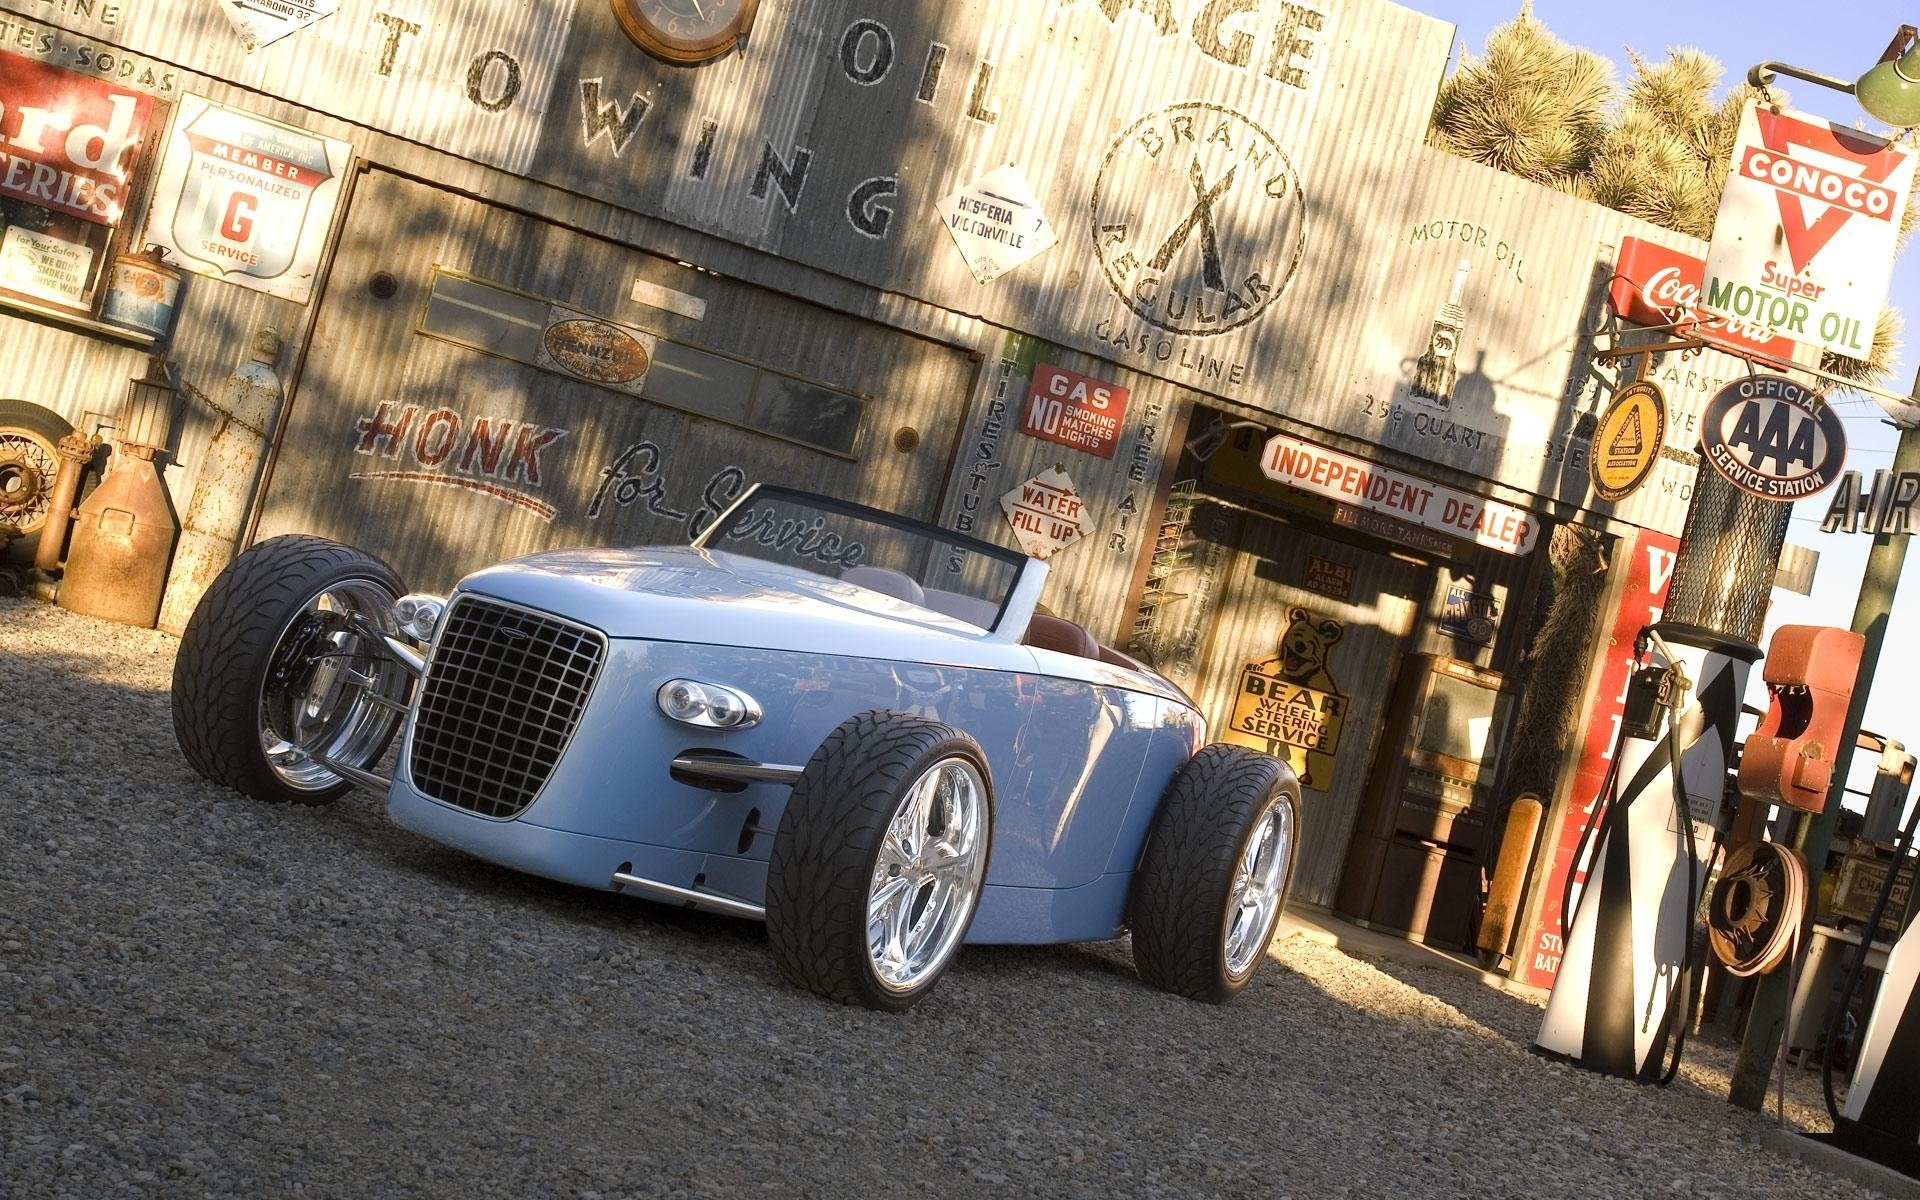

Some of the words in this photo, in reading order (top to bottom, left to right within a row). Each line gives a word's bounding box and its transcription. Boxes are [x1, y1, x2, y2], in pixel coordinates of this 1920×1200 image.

[50, 0, 120, 26] INE
[296, 10, 311, 21] 32
[668, 17, 678, 33] 6
[687, 18, 699, 34] 5
[706, 10, 716, 26] 4
[75, 46, 175, 92] SODAS
[837, 18, 998, 127] OIL
[0, 94, 137, 178] rd
[373, 11, 899, 240] TOWING
[213, 143, 299, 180] MEMBER
[258, 140, 294, 160] AMERICA
[1138, 115, 1288, 200] BRAND
[200, 162, 301, 200] PERSONALIZED
[1748, 154, 1889, 215] CONOCO
[220, 191, 258, 243] G
[951, 214, 1024, 249] VICTORVILLE
[1034, 218, 1043, 233] 7
[30, 239, 51, 251] Your
[52, 245, 81, 260] Safety
[41, 255, 55, 266] WE
[202, 240, 258, 265] SERVICE
[1409, 221, 1487, 248] MOTOR
[1496, 241, 1524, 284] OIL
[36, 264, 65, 280] SMOKE
[65, 274, 79, 284] ON
[60, 283, 80, 296] WAY
[1101, 223, 1272, 323] REGULAR
[1760, 260, 1825, 301] Super
[1708, 276, 1808, 334] MOTOR
[1820, 311, 1862, 350] OIL
[1095, 318, 1246, 386] GASOLINE
[976, 358, 1017, 462] TIRES
[1049, 374, 1112, 410] GAS
[1626, 386, 1656, 398] INTEGRITY
[1739, 381, 1825, 422] OFFICIAL
[1027, 394, 1062, 435] NO
[1065, 404, 1117, 430] SMOKING
[1061, 417, 1114, 441] MATCHES
[1413, 412, 1487, 450] QUART
[1612, 411, 1635, 447] NATIONAL
[355, 400, 567, 487] HONK
[1058, 430, 1101, 449] LIGHTS
[1127, 401, 1162, 485] FREE
[1614, 446, 1636, 455] STATION
[1727, 401, 1816, 477] AAA
[1607, 460, 1638, 468] ASSOCIATION
[1710, 444, 1765, 493] SERVICE
[1768, 472, 1825, 497] STATION
[586, 441, 687, 521] for
[688, 465, 867, 570] Service
[1022, 486, 1083, 519] WATER
[1270, 444, 1434, 517] INDEPENDENT
[1441, 498, 1531, 548] DEALER
[1819, 469, 1920, 535] AIR
[1011, 510, 1043, 535] FILL
[1050, 522, 1075, 543] UP
[1108, 491, 1138, 554] AIR
[1450, 588, 1466, 600] ALL
[1245, 675, 1340, 717] BEAR
[1259, 698, 1325, 723] WHEEL-
[1242, 716, 1329, 750] SERVICE
[1254, 707, 1328, 736] STEERING
